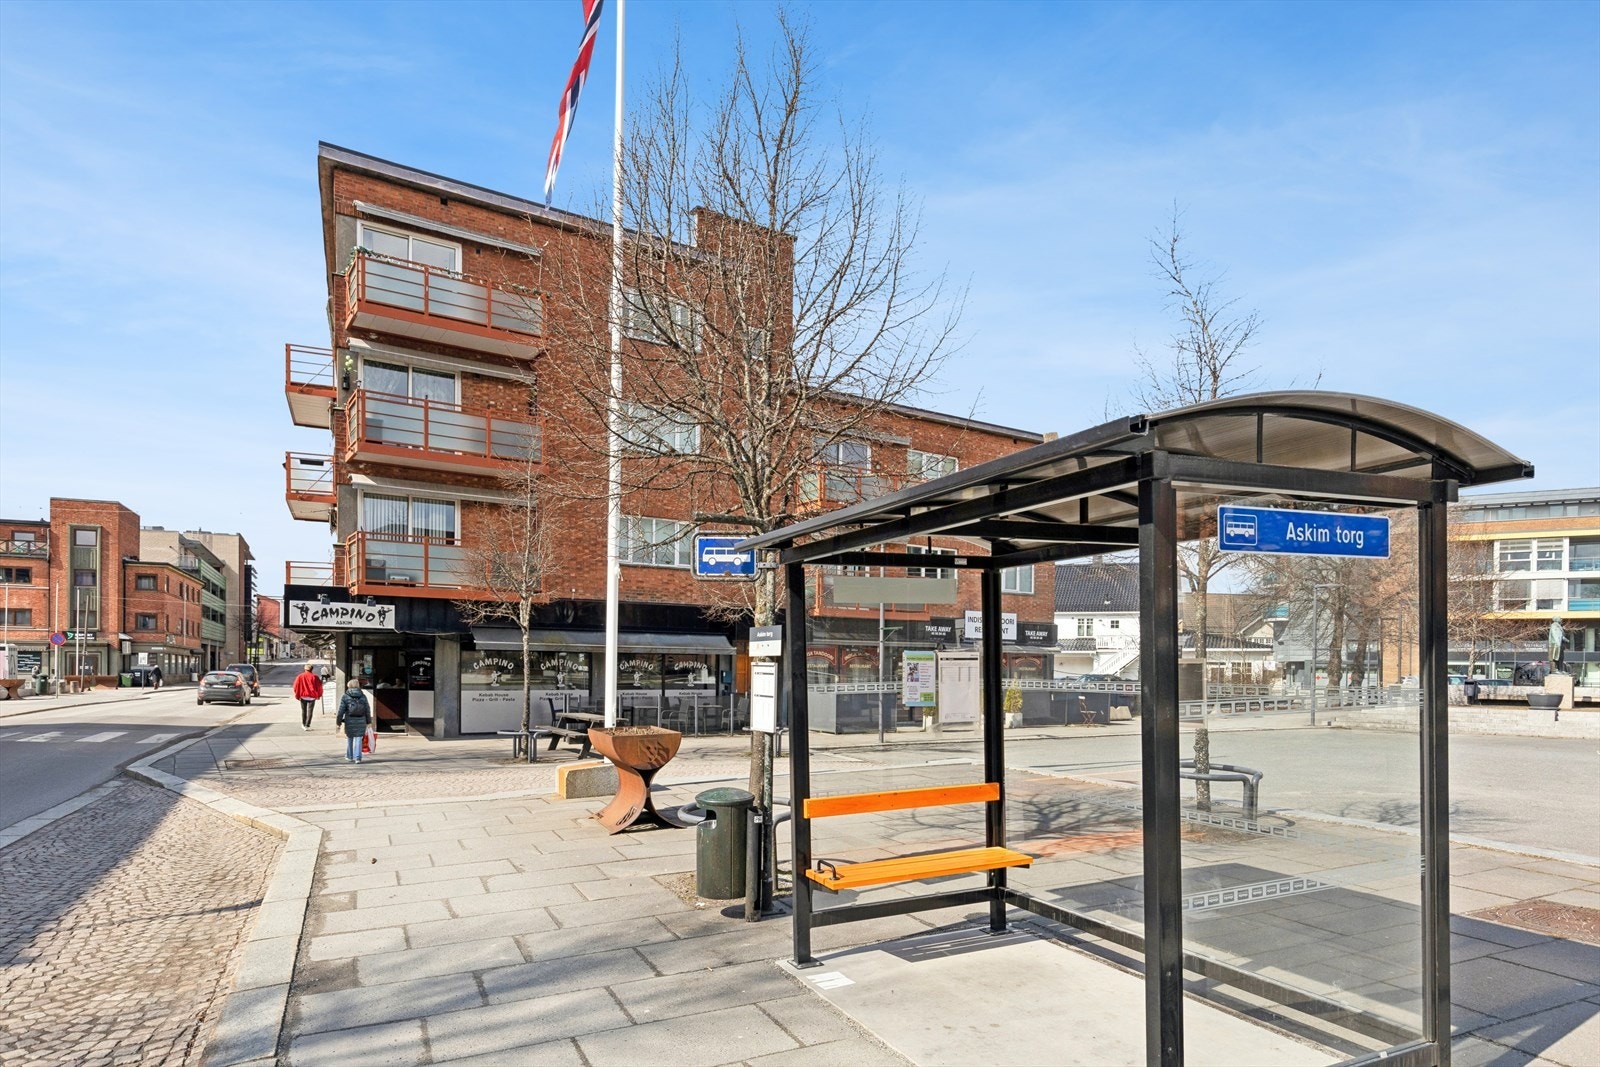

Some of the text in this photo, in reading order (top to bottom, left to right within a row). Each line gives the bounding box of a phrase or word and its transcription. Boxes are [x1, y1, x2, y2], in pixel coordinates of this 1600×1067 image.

[1286, 522, 1364, 549] Askim torg
[311, 607, 376, 622] CAMPINO
[967, 616, 983, 624] INDIS
[473, 657, 515, 670] CAMPINO
[540, 658, 579, 670] CAMPINO
[619, 659, 654, 671] CAMPINO
[674, 660, 708, 671] CAMPINO
